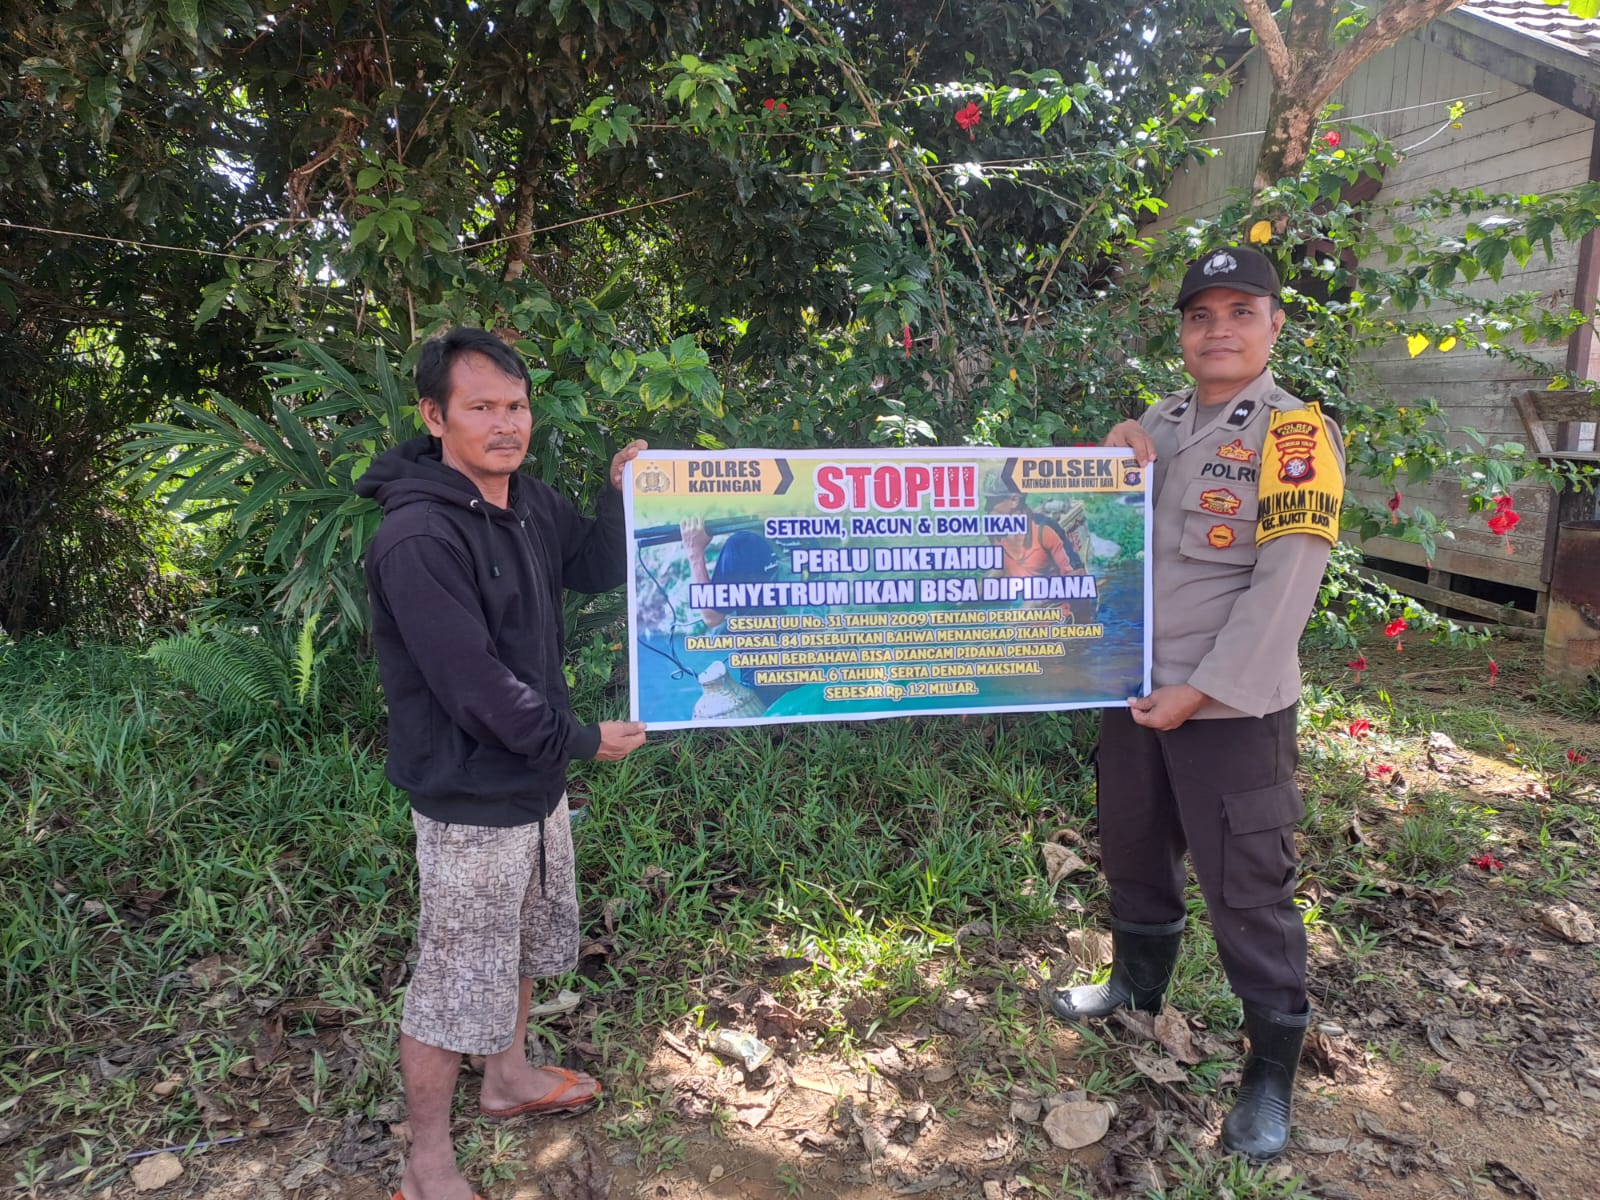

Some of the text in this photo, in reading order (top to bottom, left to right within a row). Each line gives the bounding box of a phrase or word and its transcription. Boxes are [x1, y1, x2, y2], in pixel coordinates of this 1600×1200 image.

[688, 460, 761, 478] POLRES
[1022, 459, 1113, 478] POLSEK
[1200, 463, 1256, 482] POLRI
[688, 479, 761, 493] KATINGAN
[816, 465, 976, 509] STOP!!!
[766, 516, 1026, 538] SETRUM, RACUN & BOM IKAN
[792, 547, 1003, 573] PERLU DIKETAHUI
[690, 576, 1097, 608] MENYETRUM IKAN BISA DIPIDANA
[729, 609, 1064, 630] SESUAI UU No. 31 TAHUN 2009 TENTANG PERIKANAN,
[687, 625, 1102, 650] DALAM PASAL 84 DISEBUTKAN BAHWA MENANGKAP IKAN DENGAN
[731, 644, 1064, 667] BAHAN BERBAHAYA BISA DIANCAM PIDANA PENJARA
[756, 662, 1041, 685] MAKSIMAL 6 TAHUN, SERTA DENDA MAKSIMAL
[826, 681, 977, 700] SEBESAR Rp. 1.2 MILIAR.
